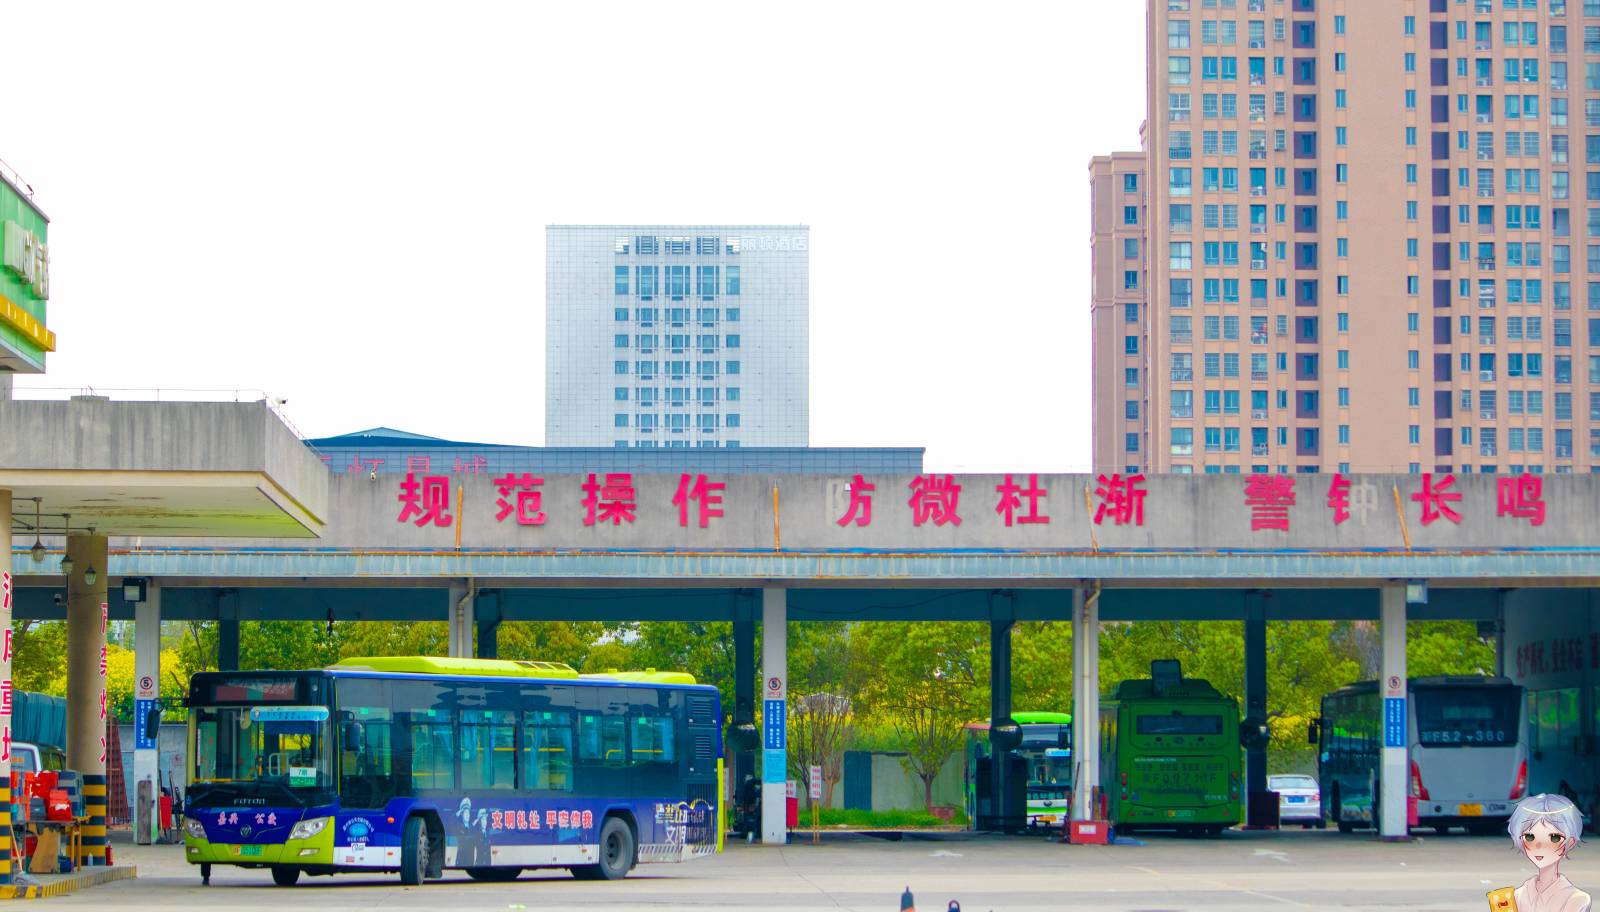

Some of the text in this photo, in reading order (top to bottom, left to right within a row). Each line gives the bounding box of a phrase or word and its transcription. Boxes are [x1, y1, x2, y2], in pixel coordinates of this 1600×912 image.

[398, 474, 724, 528] 规范操作
[1246, 474, 1546, 531] 警钟长鸣
[491, 810, 541, 830] 文明礼让
